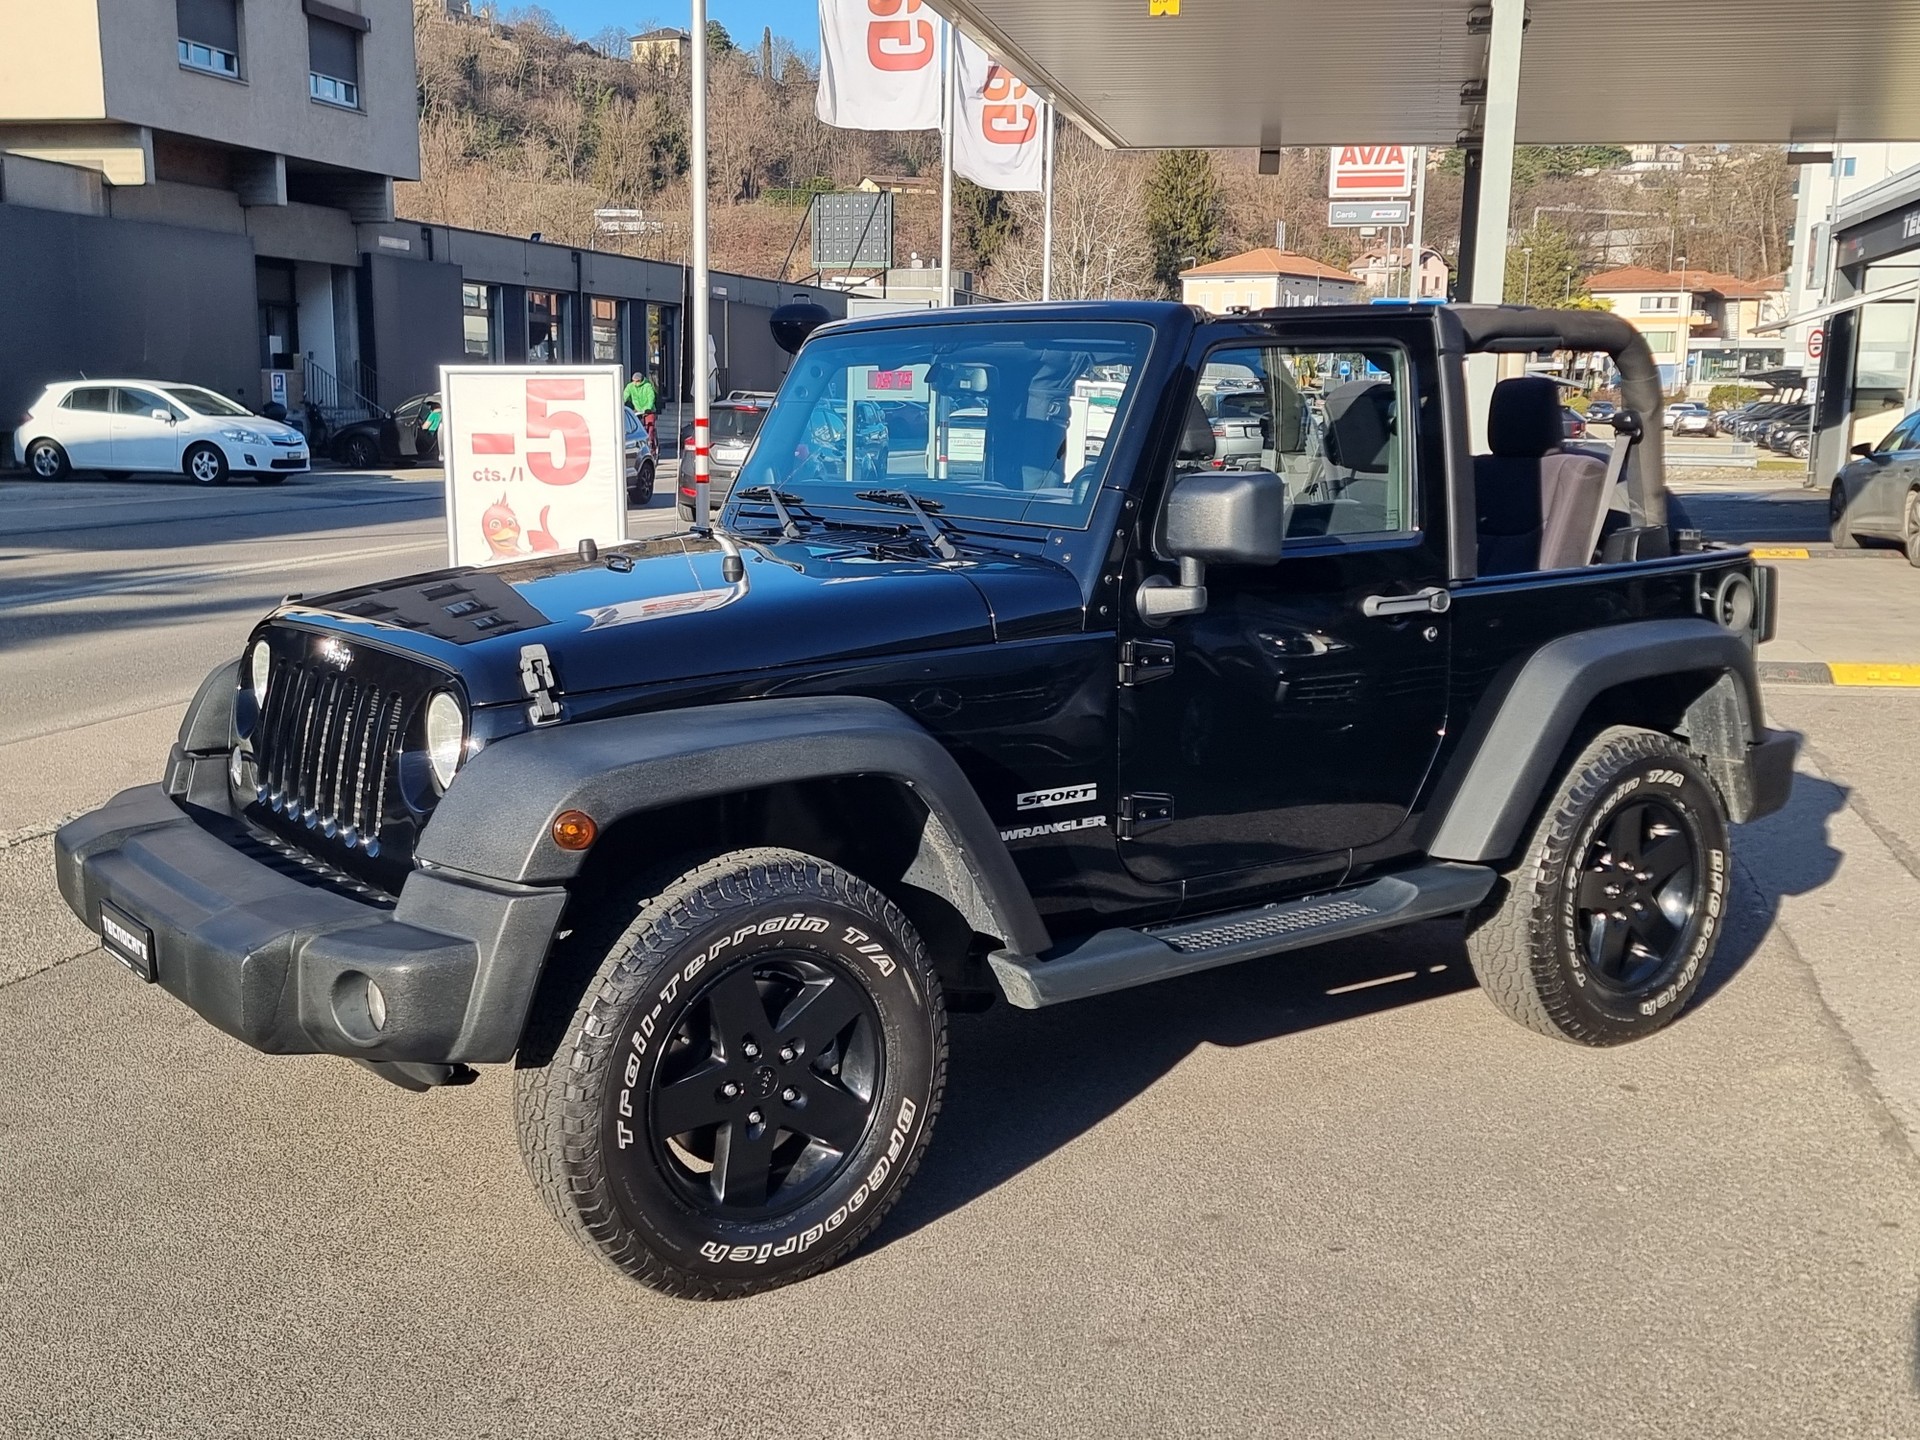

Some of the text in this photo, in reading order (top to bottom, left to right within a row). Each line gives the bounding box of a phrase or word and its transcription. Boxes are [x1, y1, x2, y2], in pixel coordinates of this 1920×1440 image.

[1338, 145, 1405, 165] AVIA
[1646, 768, 1685, 788] T/A
[1020, 787, 1093, 806] SPORT
[1000, 815, 1107, 842] WRANGLER
[842, 926, 897, 977] T/A
[700, 1096, 917, 1265] BFGoodrich
